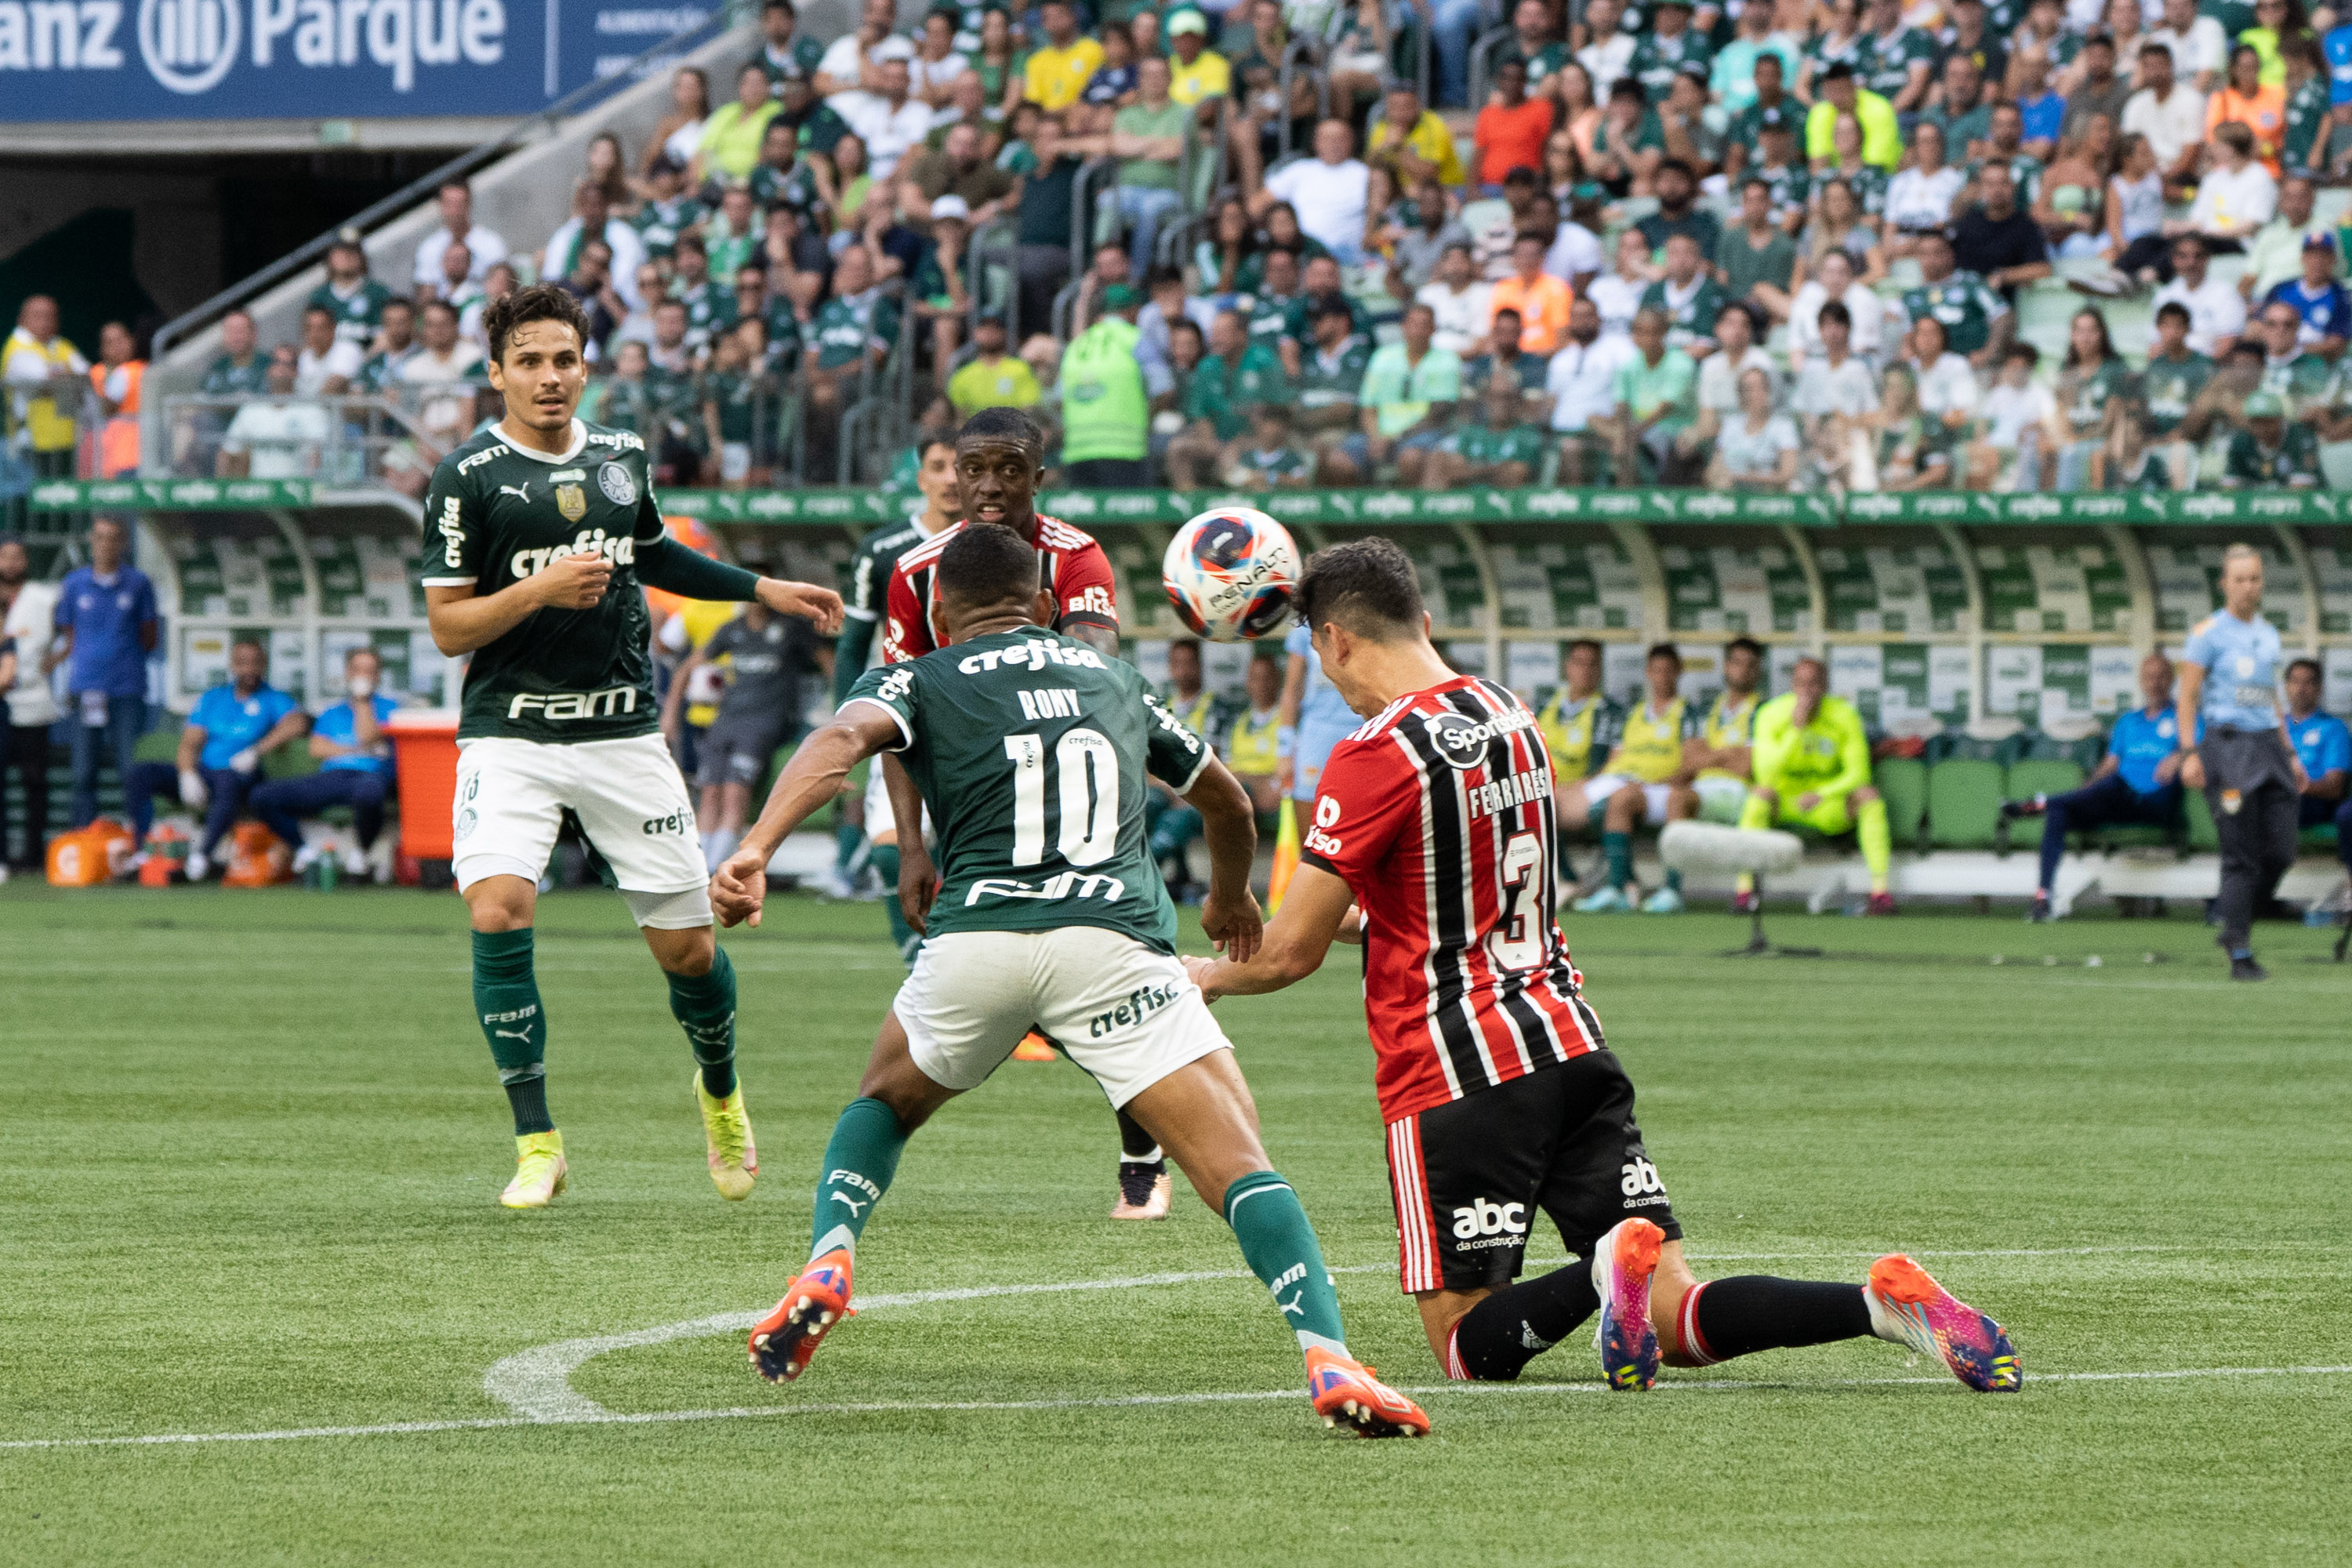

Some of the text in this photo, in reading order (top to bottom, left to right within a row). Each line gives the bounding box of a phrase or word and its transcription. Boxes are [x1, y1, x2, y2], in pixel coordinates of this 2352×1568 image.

[252, 0, 506, 93] Parque
[588, 433, 645, 451] crefisa
[437, 496, 466, 568] crefisa
[1208, 546, 1286, 609] PENALT
[958, 638, 1108, 675] crefisa
[1017, 688, 1081, 720] RONY
[1068, 735, 1103, 746] crefisa
[1004, 728, 1120, 866] 10
[643, 804, 695, 836] cref
[1304, 824, 1342, 855] itso
[1491, 831, 1544, 972] 3
[1453, 1197, 1526, 1239] abc
[1623, 1198, 1636, 1208] da
[1456, 1234, 1525, 1251] da construção
[1270, 1262, 1308, 1296] am
